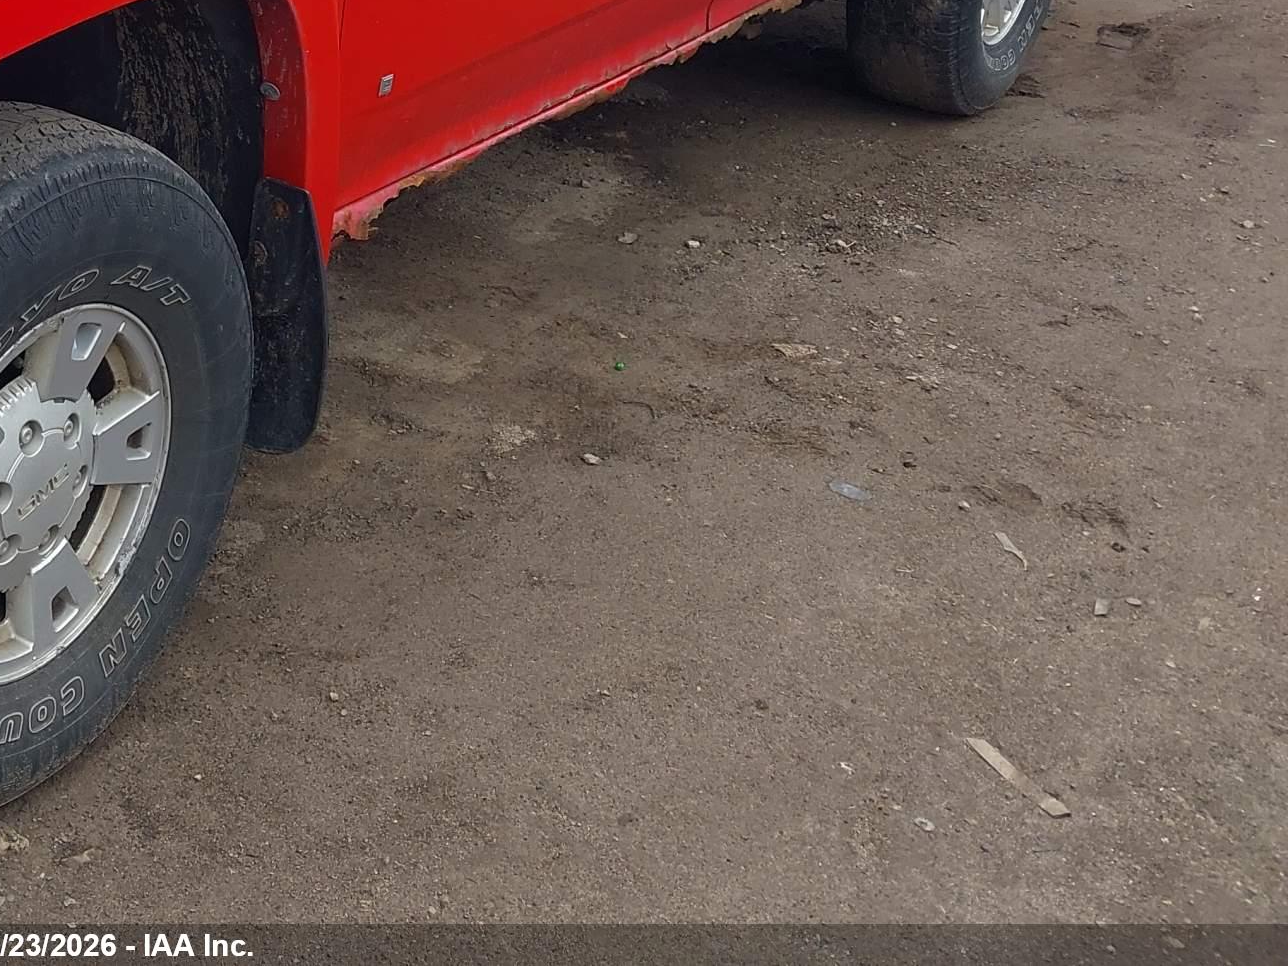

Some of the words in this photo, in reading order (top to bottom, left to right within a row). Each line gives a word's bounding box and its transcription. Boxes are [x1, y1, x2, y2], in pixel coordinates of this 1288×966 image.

[111, 264, 192, 306] A/T
[17, 463, 71, 522] GMC
[97, 518, 192, 678] OPEN
